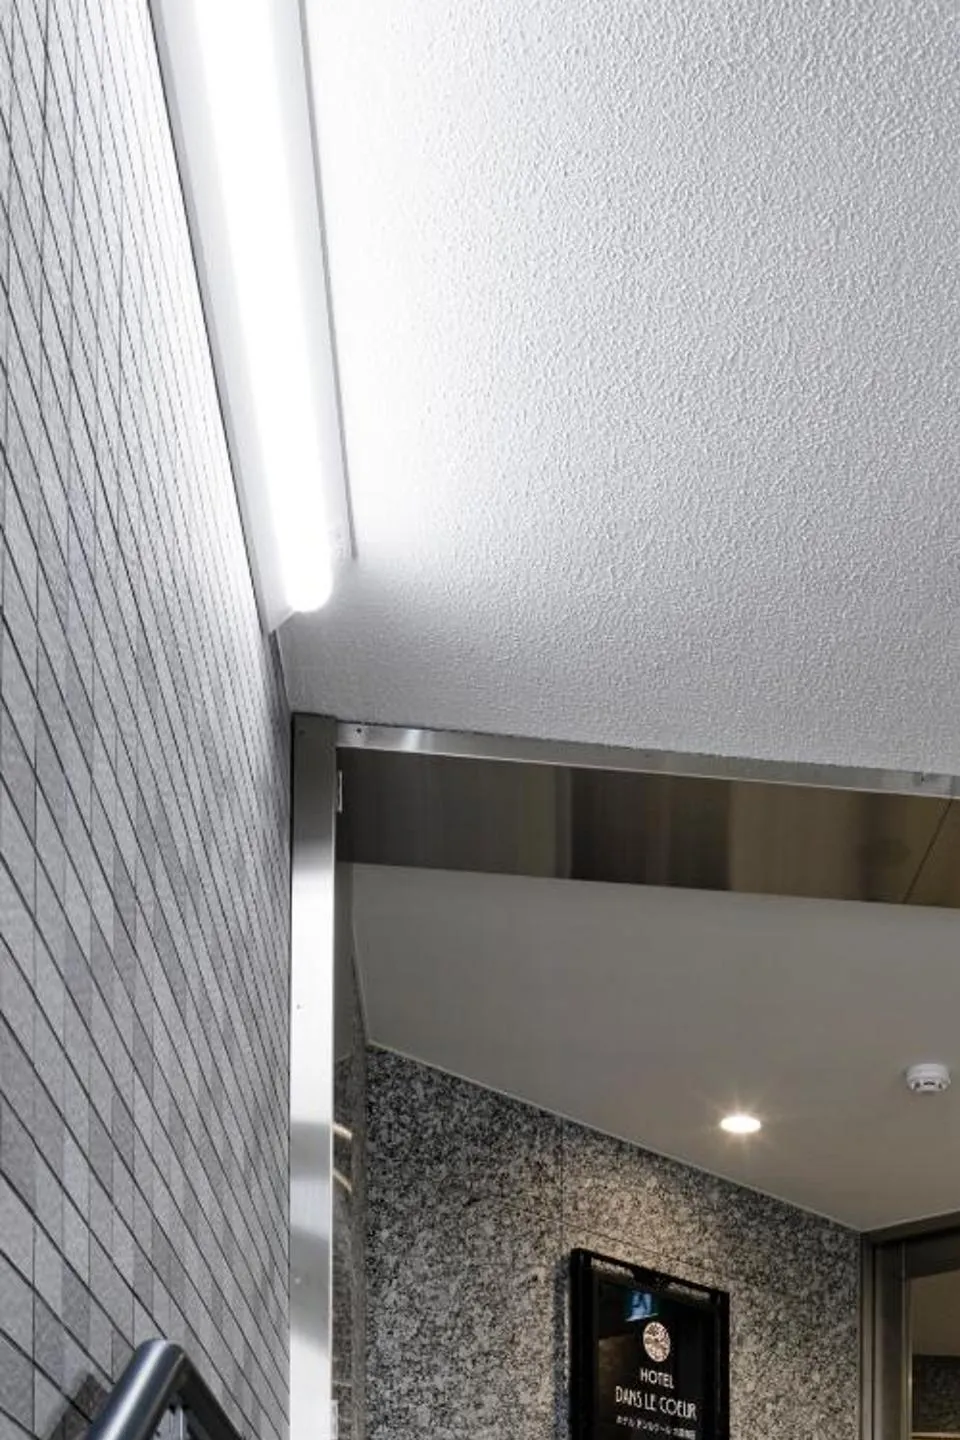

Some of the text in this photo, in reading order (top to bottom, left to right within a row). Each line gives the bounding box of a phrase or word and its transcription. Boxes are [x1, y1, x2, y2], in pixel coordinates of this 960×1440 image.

[640, 1367, 675, 1389] HOTEL
[615, 1385, 698, 1420] DANS LE COEUR
